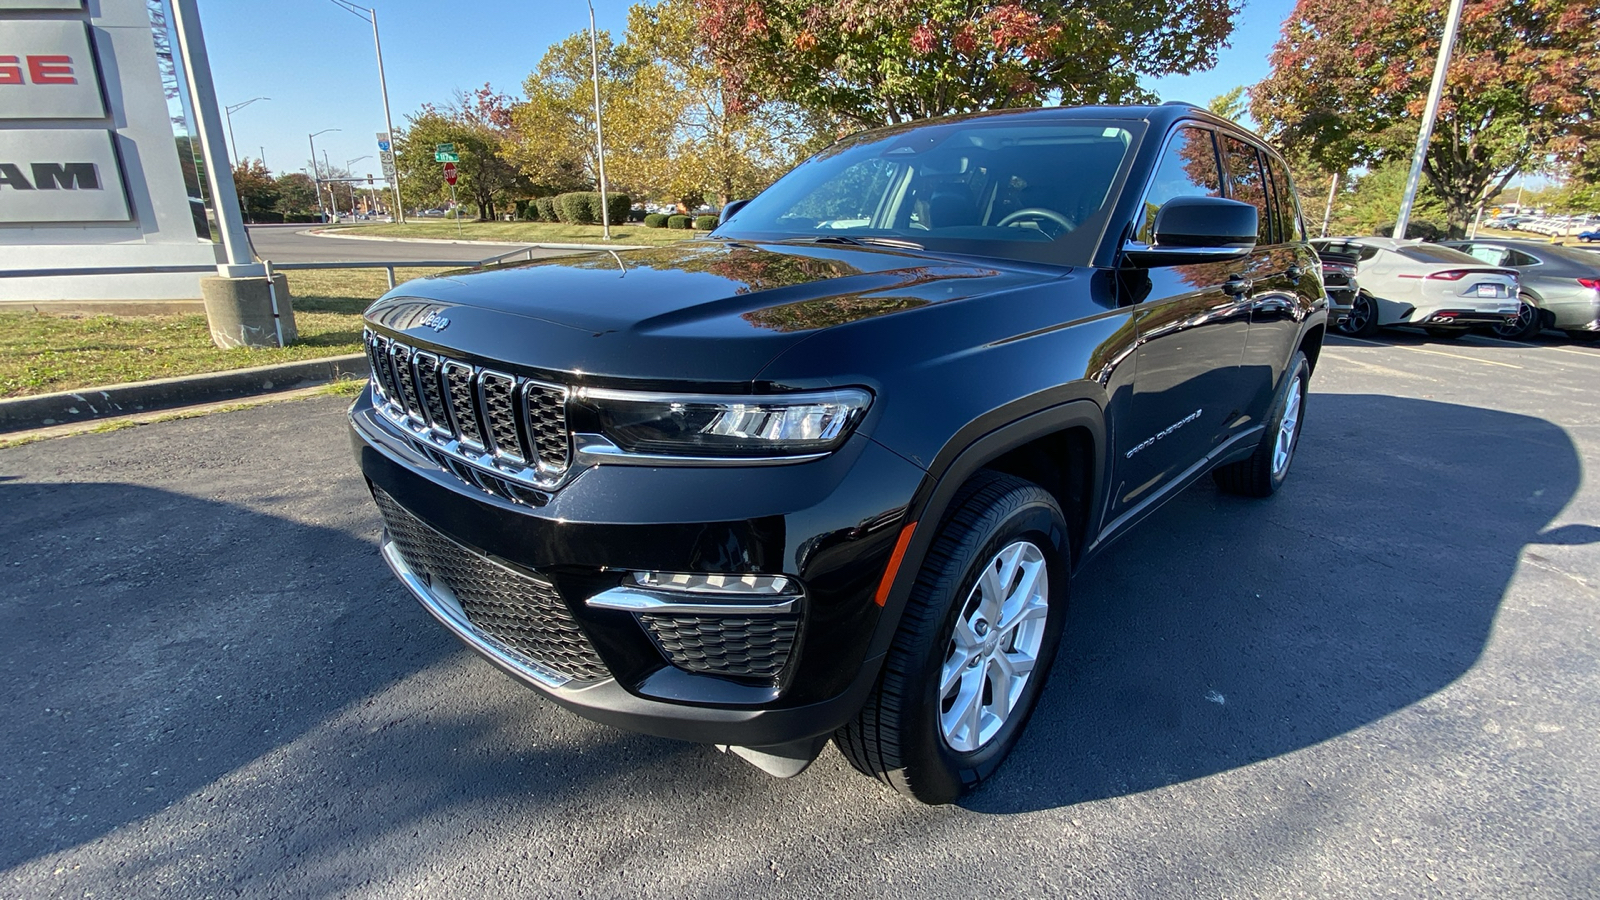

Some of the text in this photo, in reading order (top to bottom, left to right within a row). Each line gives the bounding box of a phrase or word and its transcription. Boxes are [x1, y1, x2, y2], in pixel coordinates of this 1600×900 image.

[383, 165, 394, 173] 56
[444, 169, 457, 179] STOP
[419, 311, 450, 332] Jeep
[1126, 412, 1197, 459] GRAND CHEROKEE
